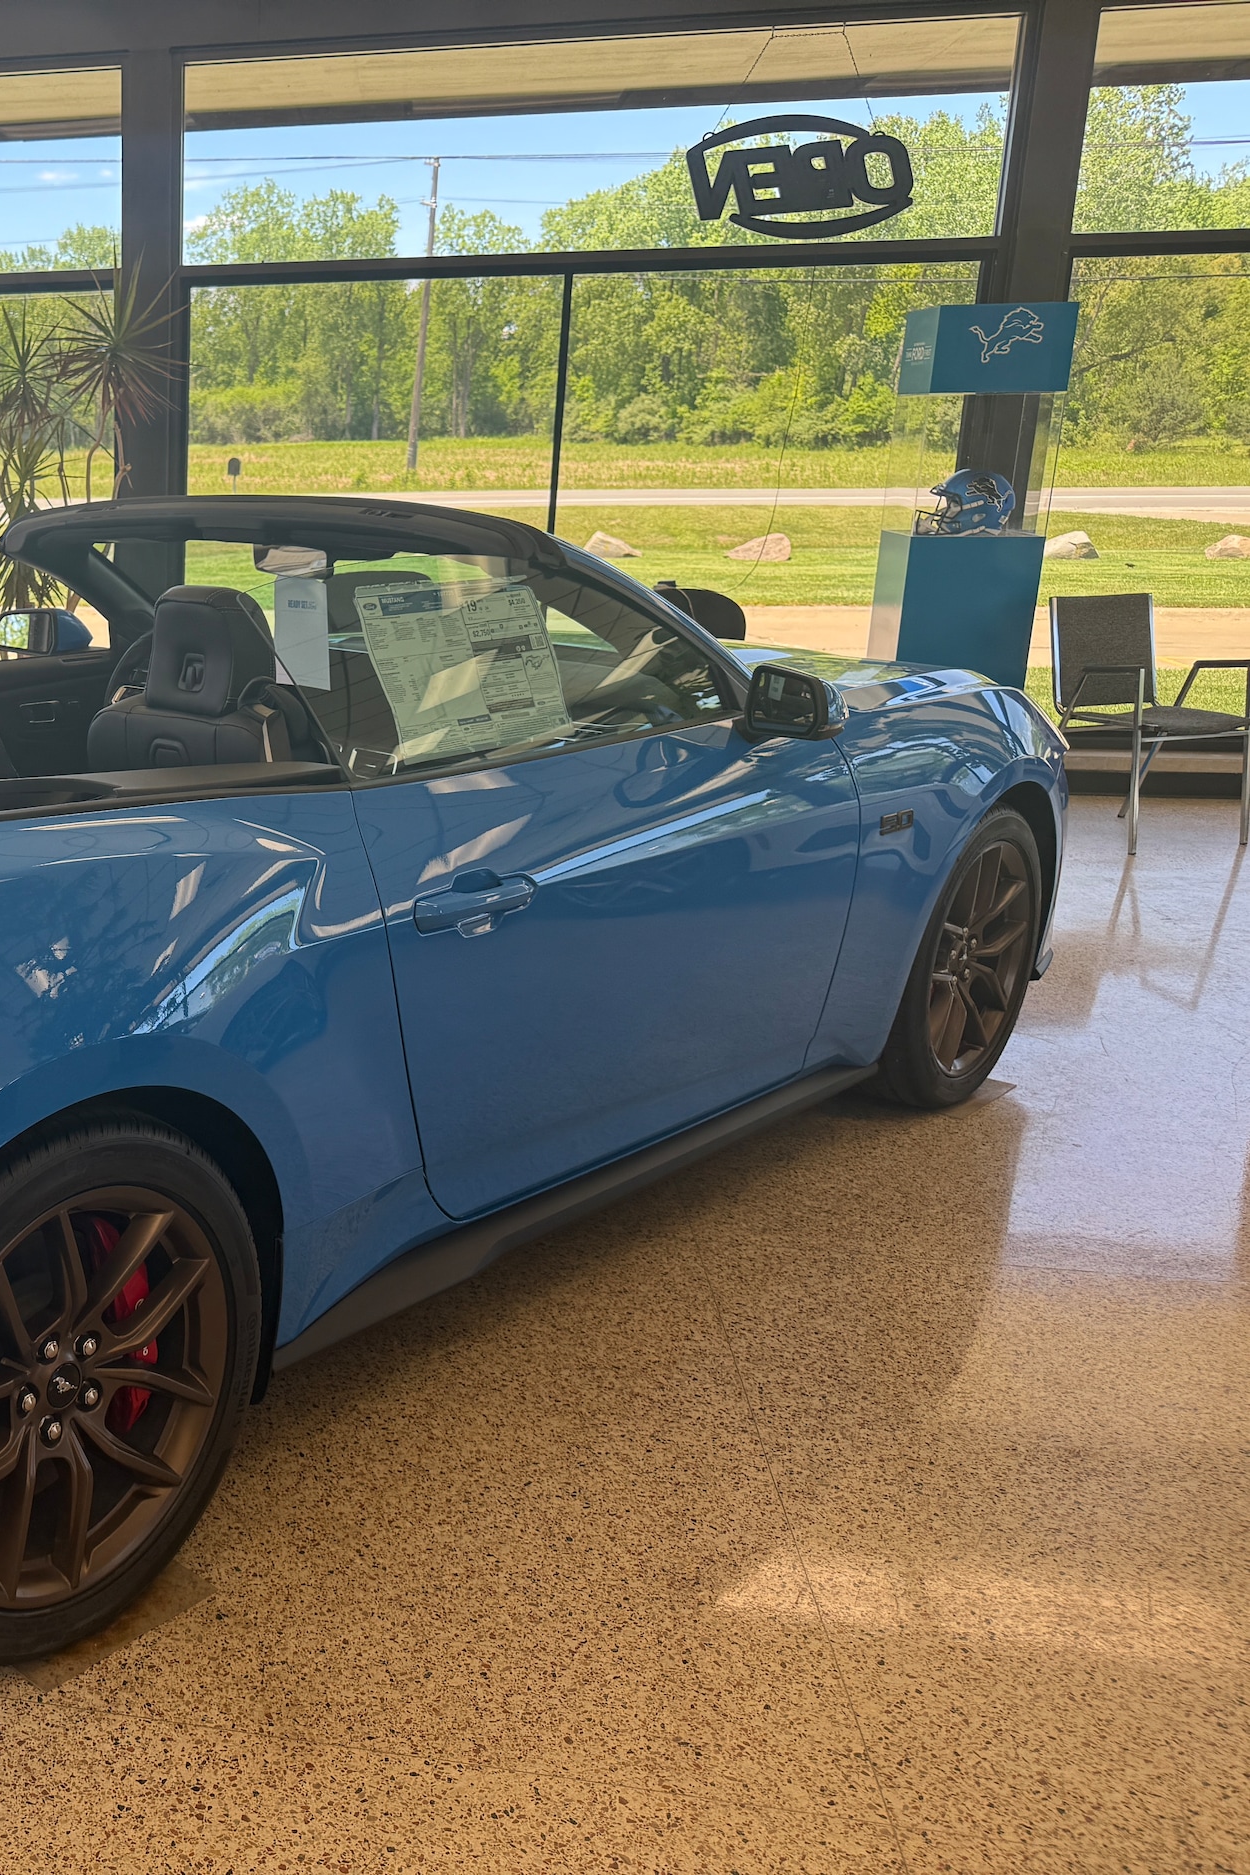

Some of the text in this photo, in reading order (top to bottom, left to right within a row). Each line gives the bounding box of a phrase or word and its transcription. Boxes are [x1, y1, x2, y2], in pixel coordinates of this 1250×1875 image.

[381, 596, 405, 604] MUSTANG
[467, 601, 477, 612] 19
[879, 808, 914, 836] 5.0
